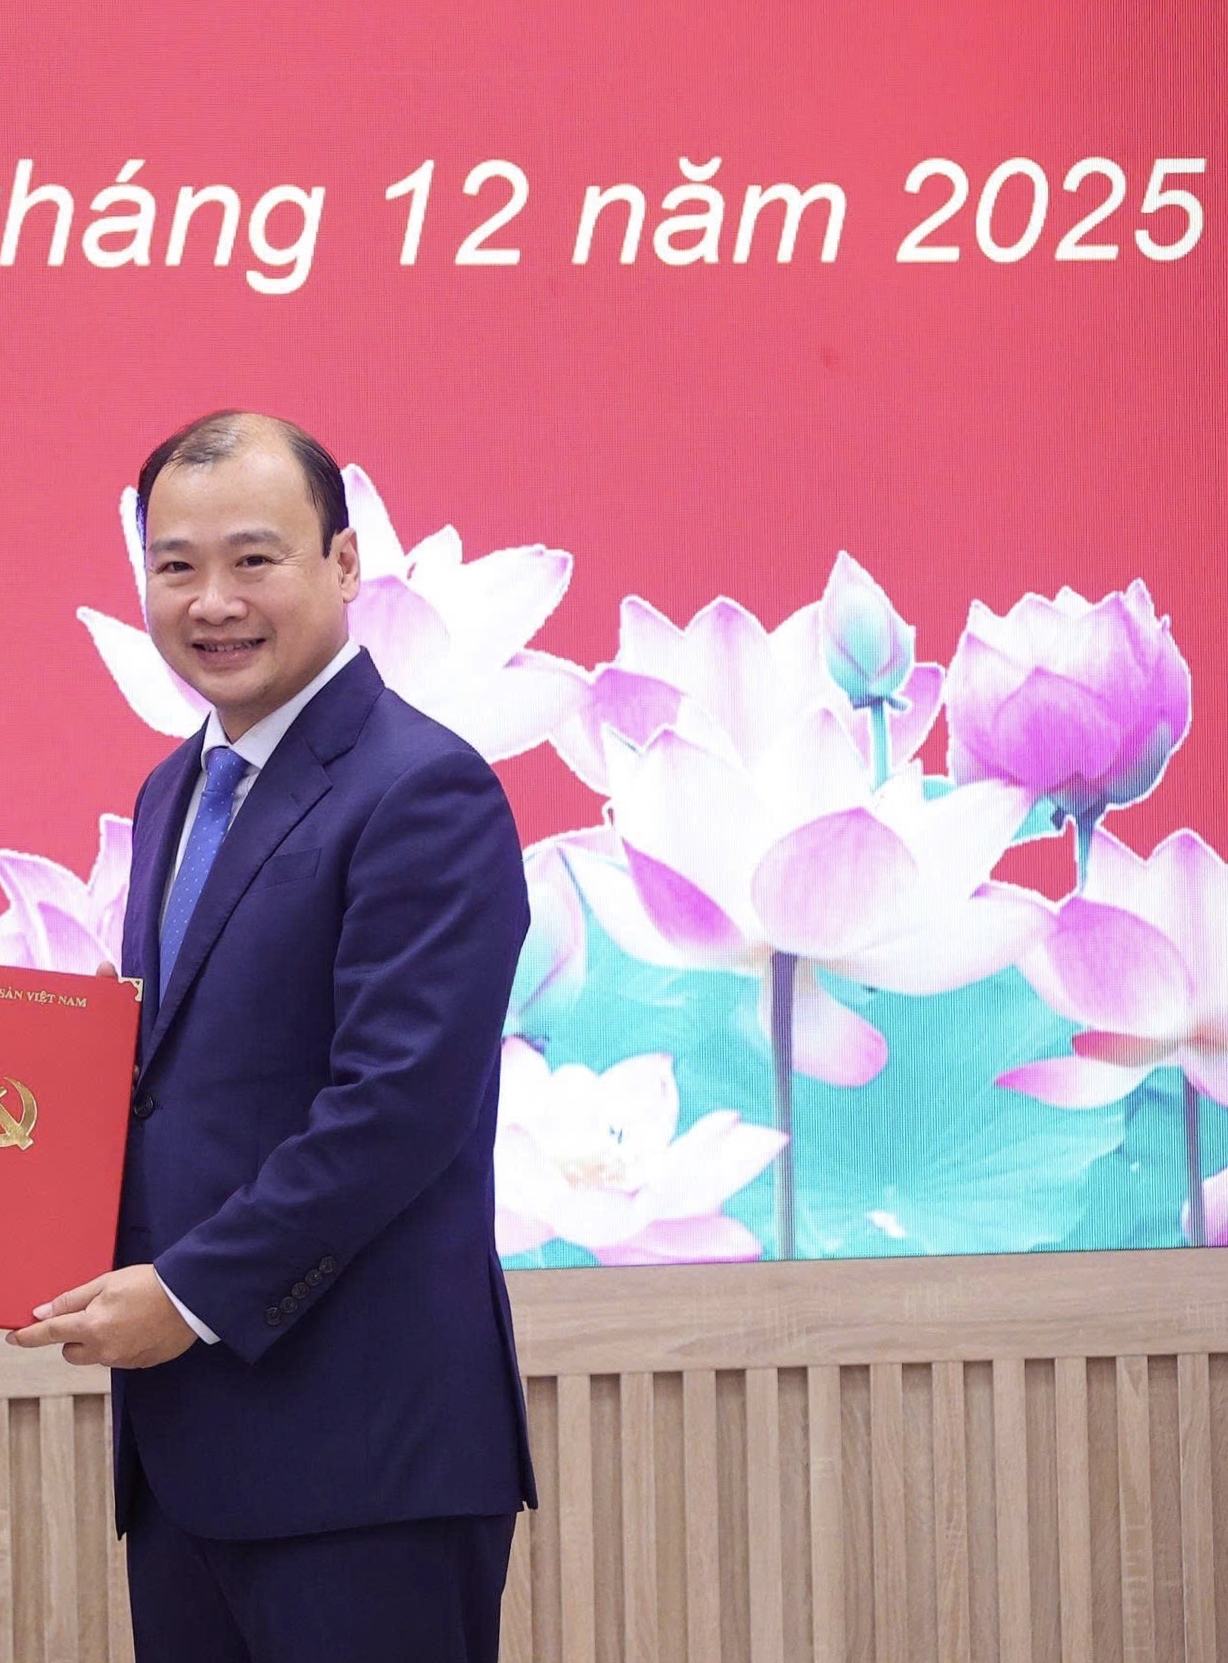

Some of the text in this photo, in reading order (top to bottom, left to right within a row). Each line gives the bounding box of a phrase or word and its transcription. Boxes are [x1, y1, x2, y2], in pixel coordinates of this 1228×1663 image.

[384, 158, 529, 266] 12
[571, 155, 847, 266] năm
[895, 156, 1206, 264] 2025
[26, 991, 56, 1005] VIỆT
[58, 996, 87, 1008] NAM
